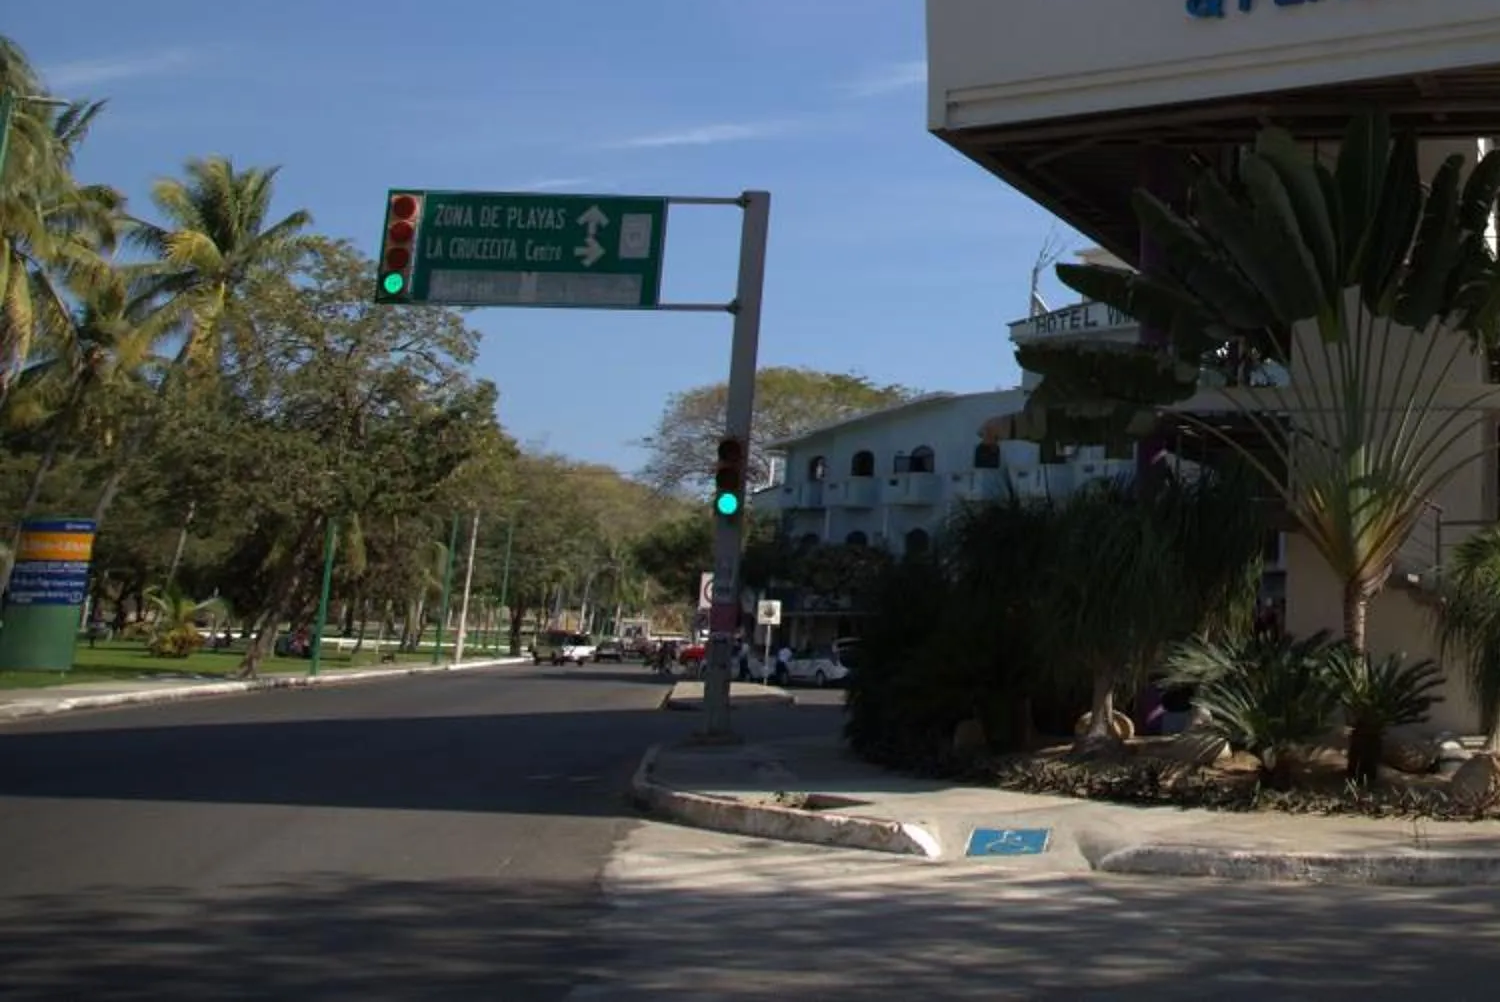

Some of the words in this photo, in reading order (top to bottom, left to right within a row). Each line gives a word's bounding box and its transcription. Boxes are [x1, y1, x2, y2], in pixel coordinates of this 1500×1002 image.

[434, 204, 473, 228] ZONA
[480, 206, 503, 228] DE
[507, 207, 567, 230] PLAYAS
[425, 236, 443, 260] LA
[449, 237, 518, 261] CRUCECITA
[524, 240, 563, 262] Centro
[1034, 307, 1098, 334] HOTEL
